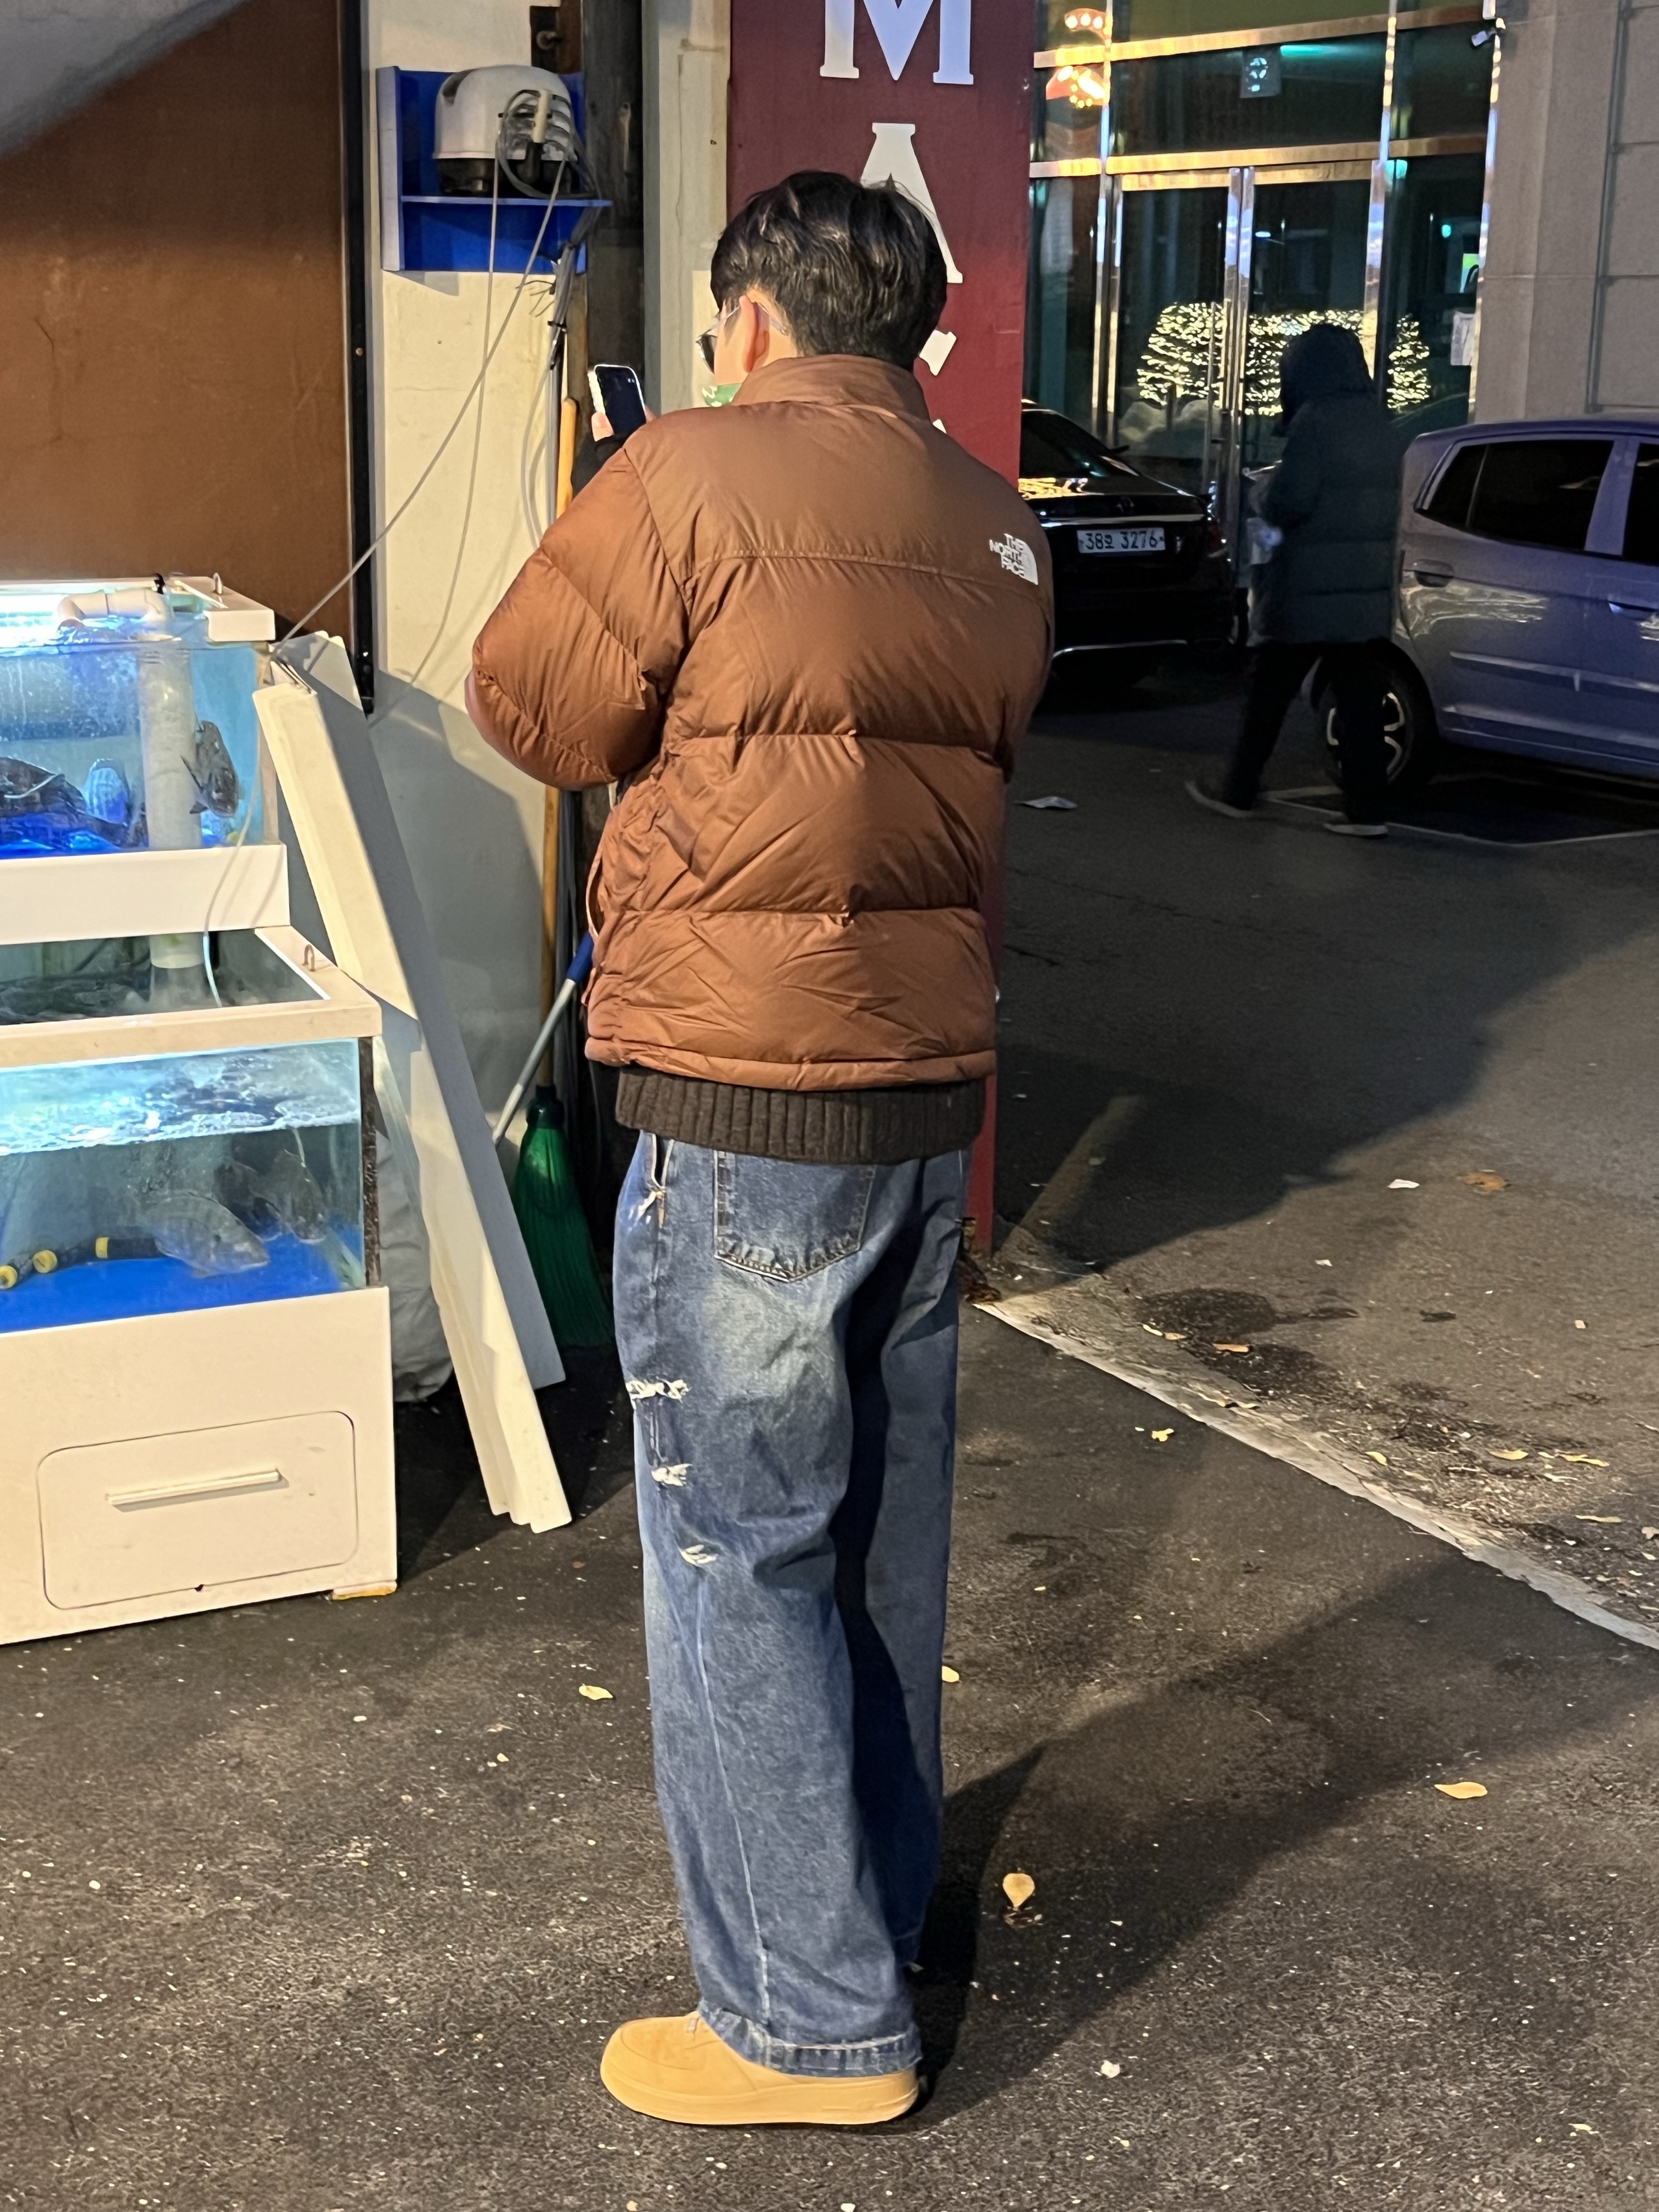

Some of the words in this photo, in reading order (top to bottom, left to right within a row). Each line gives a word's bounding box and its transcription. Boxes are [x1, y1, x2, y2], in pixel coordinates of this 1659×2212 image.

[1003, 533, 1024, 551] THE
[1120, 530, 1158, 549] 3276
[1001, 555, 1025, 578] FACE
